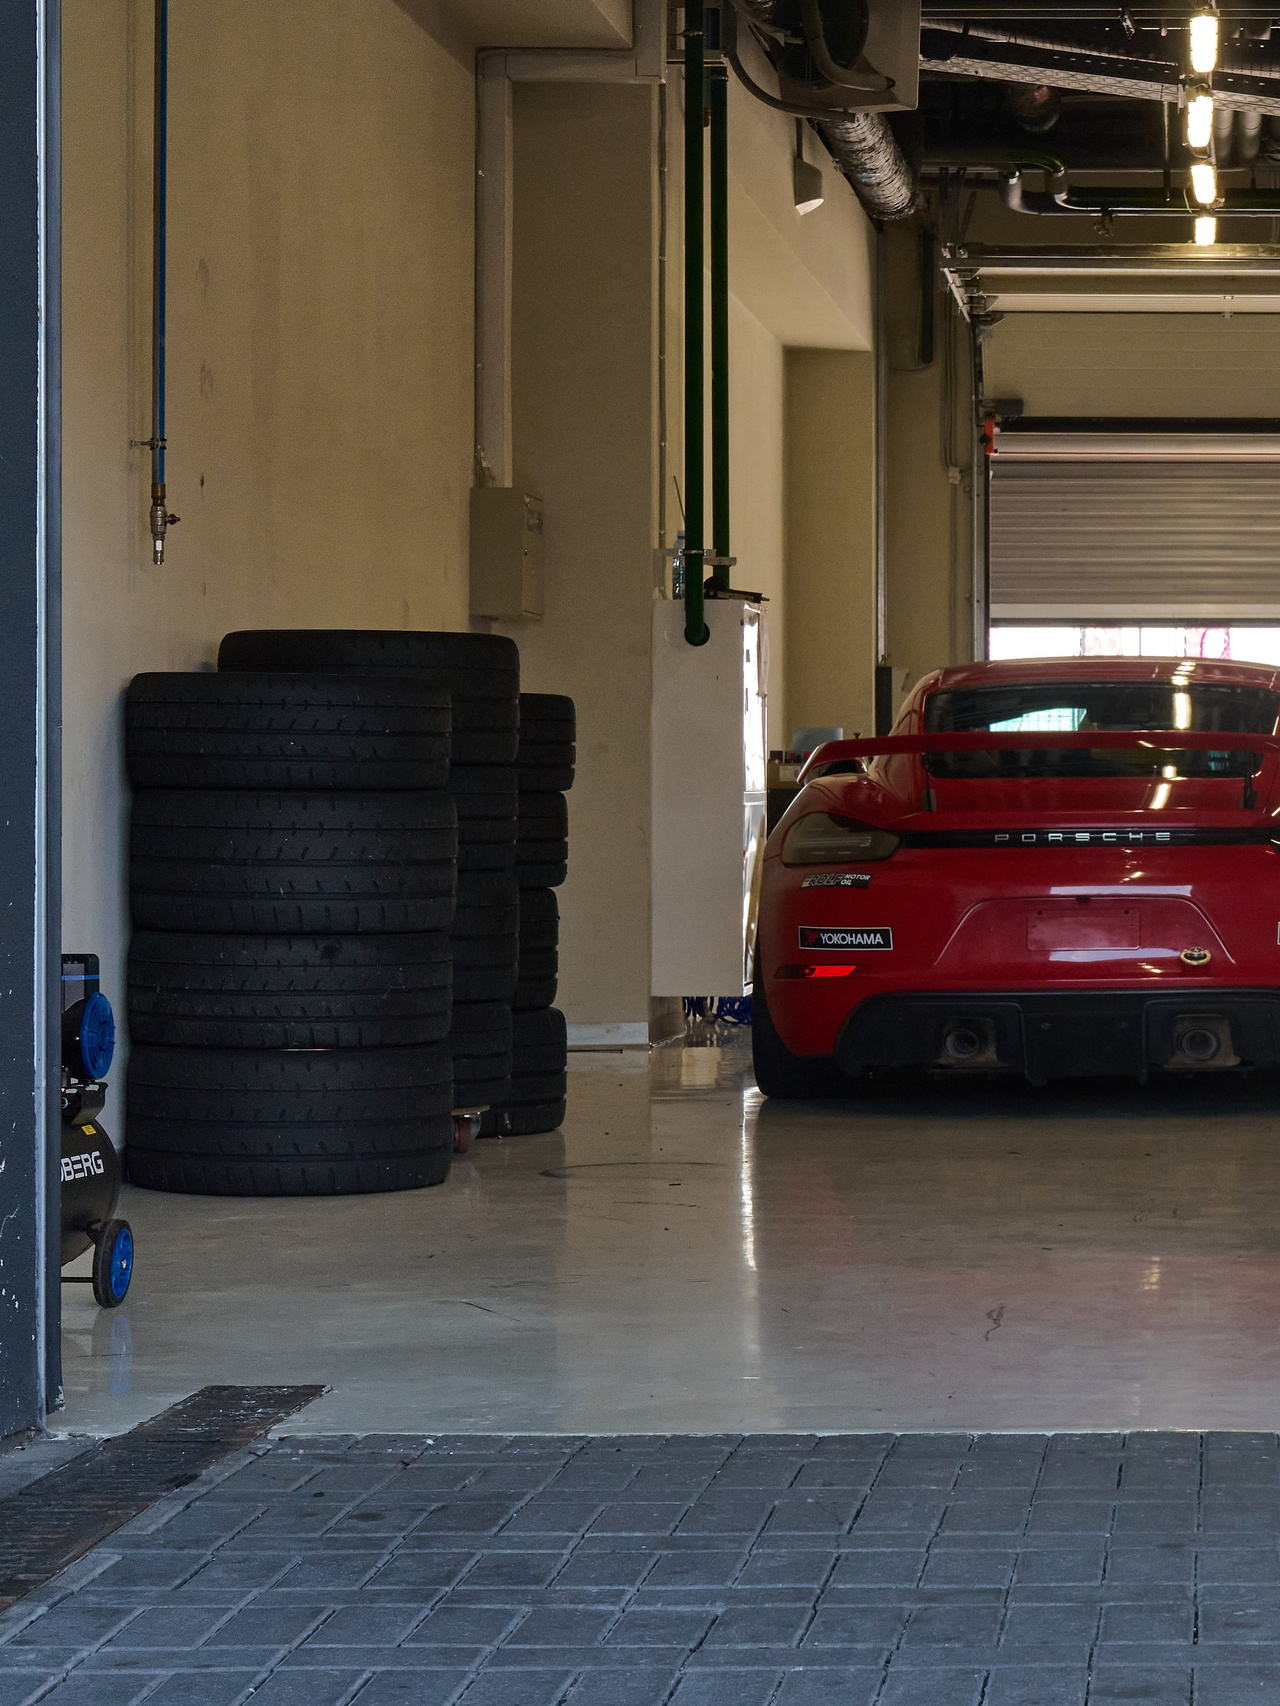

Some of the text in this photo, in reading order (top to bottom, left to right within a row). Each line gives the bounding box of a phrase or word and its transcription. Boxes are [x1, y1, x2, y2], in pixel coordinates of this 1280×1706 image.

[994, 832, 1171, 843] PORSCHE
[808, 873, 871, 886] ROLF MOTOR
[820, 932, 884, 945] YOKOHAMA
[61, 1150, 104, 1182] BERG
